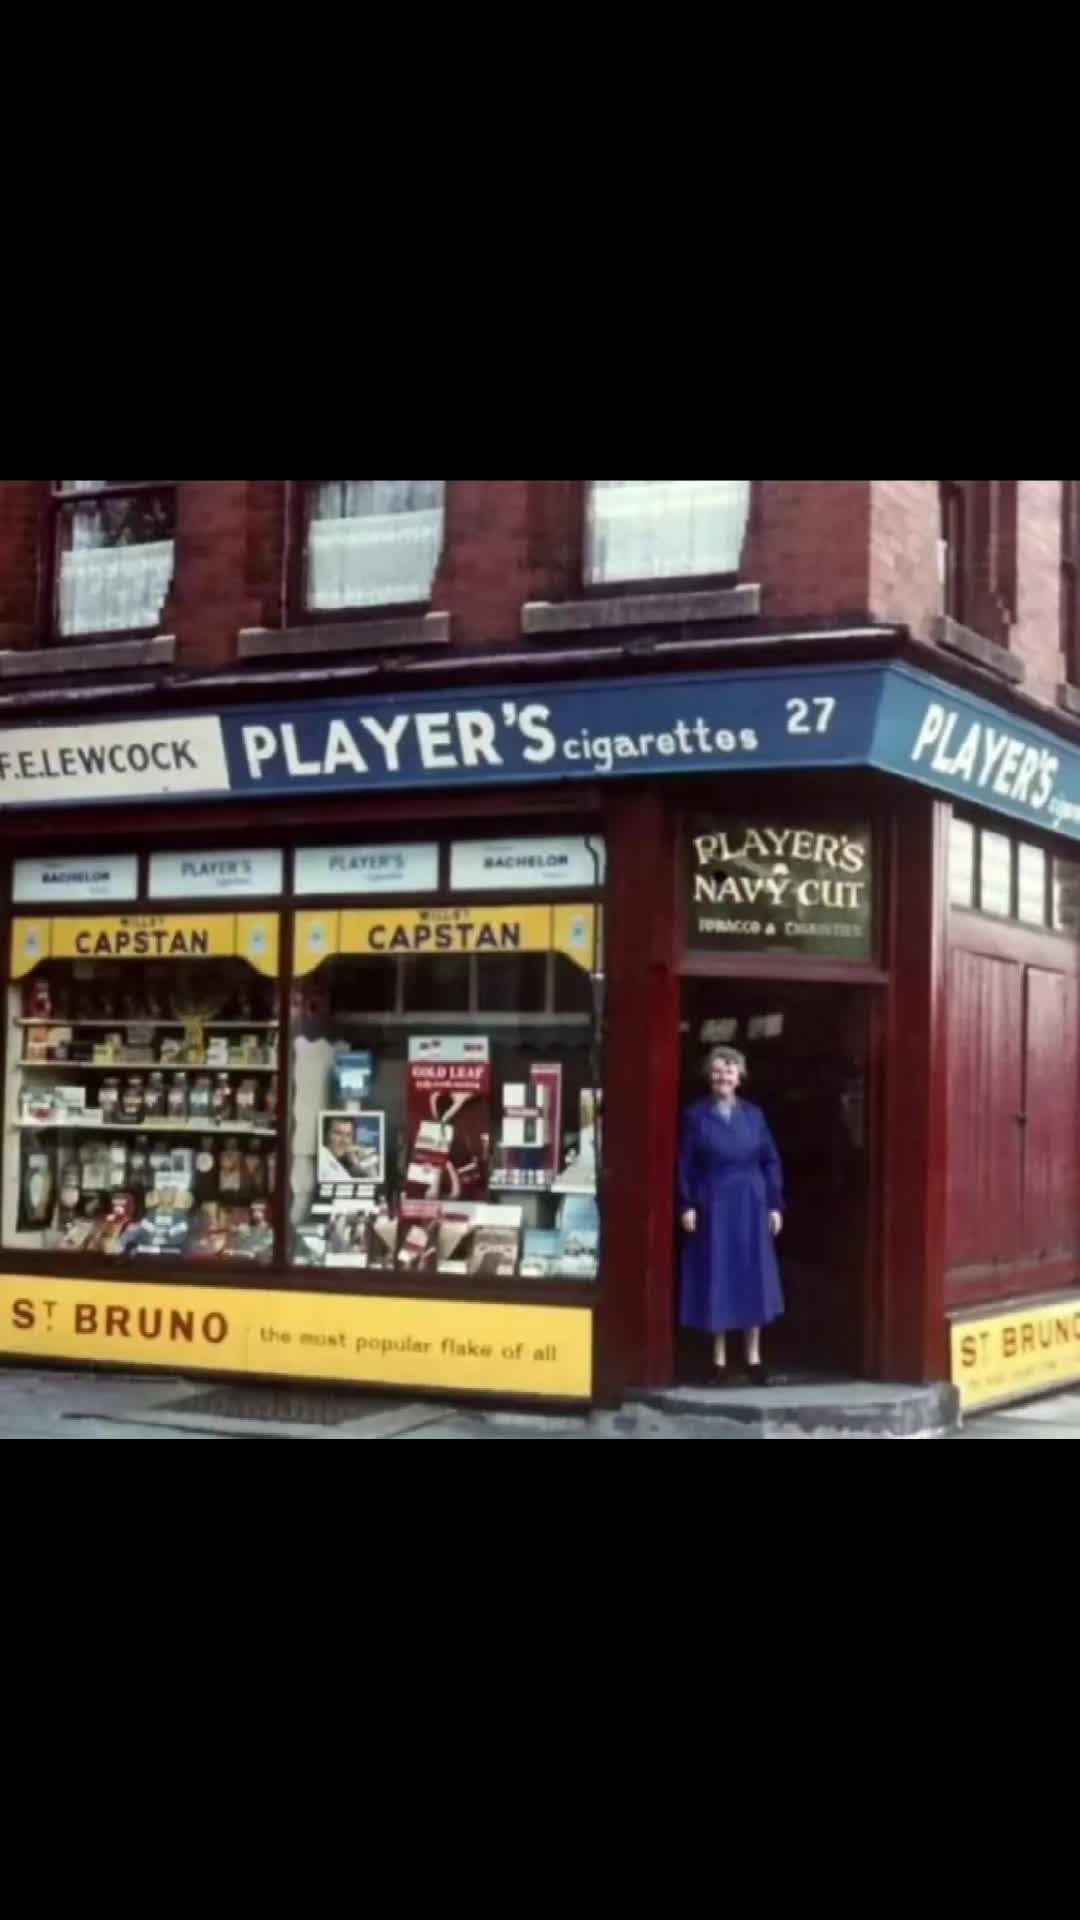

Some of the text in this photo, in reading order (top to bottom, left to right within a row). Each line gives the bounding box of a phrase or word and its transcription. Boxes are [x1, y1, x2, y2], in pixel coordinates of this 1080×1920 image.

[785, 697, 837, 734] 27
[241, 702, 759, 780] PLAYER'S cigarettes
[911, 703, 1060, 809] PLAYER'S
[328, 853, 405, 872] PLAYER'S
[483, 854, 569, 869] BACHELOR
[693, 828, 866, 873] PLAYER'S
[181, 859, 251, 878] PLAYER'S
[694, 873, 864, 909] NAVY CUT
[75, 929, 209, 954] CAPSTAN
[368, 922, 520, 951] CAPSTAN
[449, 1065, 485, 1079] LEAF
[74, 1303, 229, 1344] BRUNO
[259, 1327, 557, 1362] the most popular flake of all
